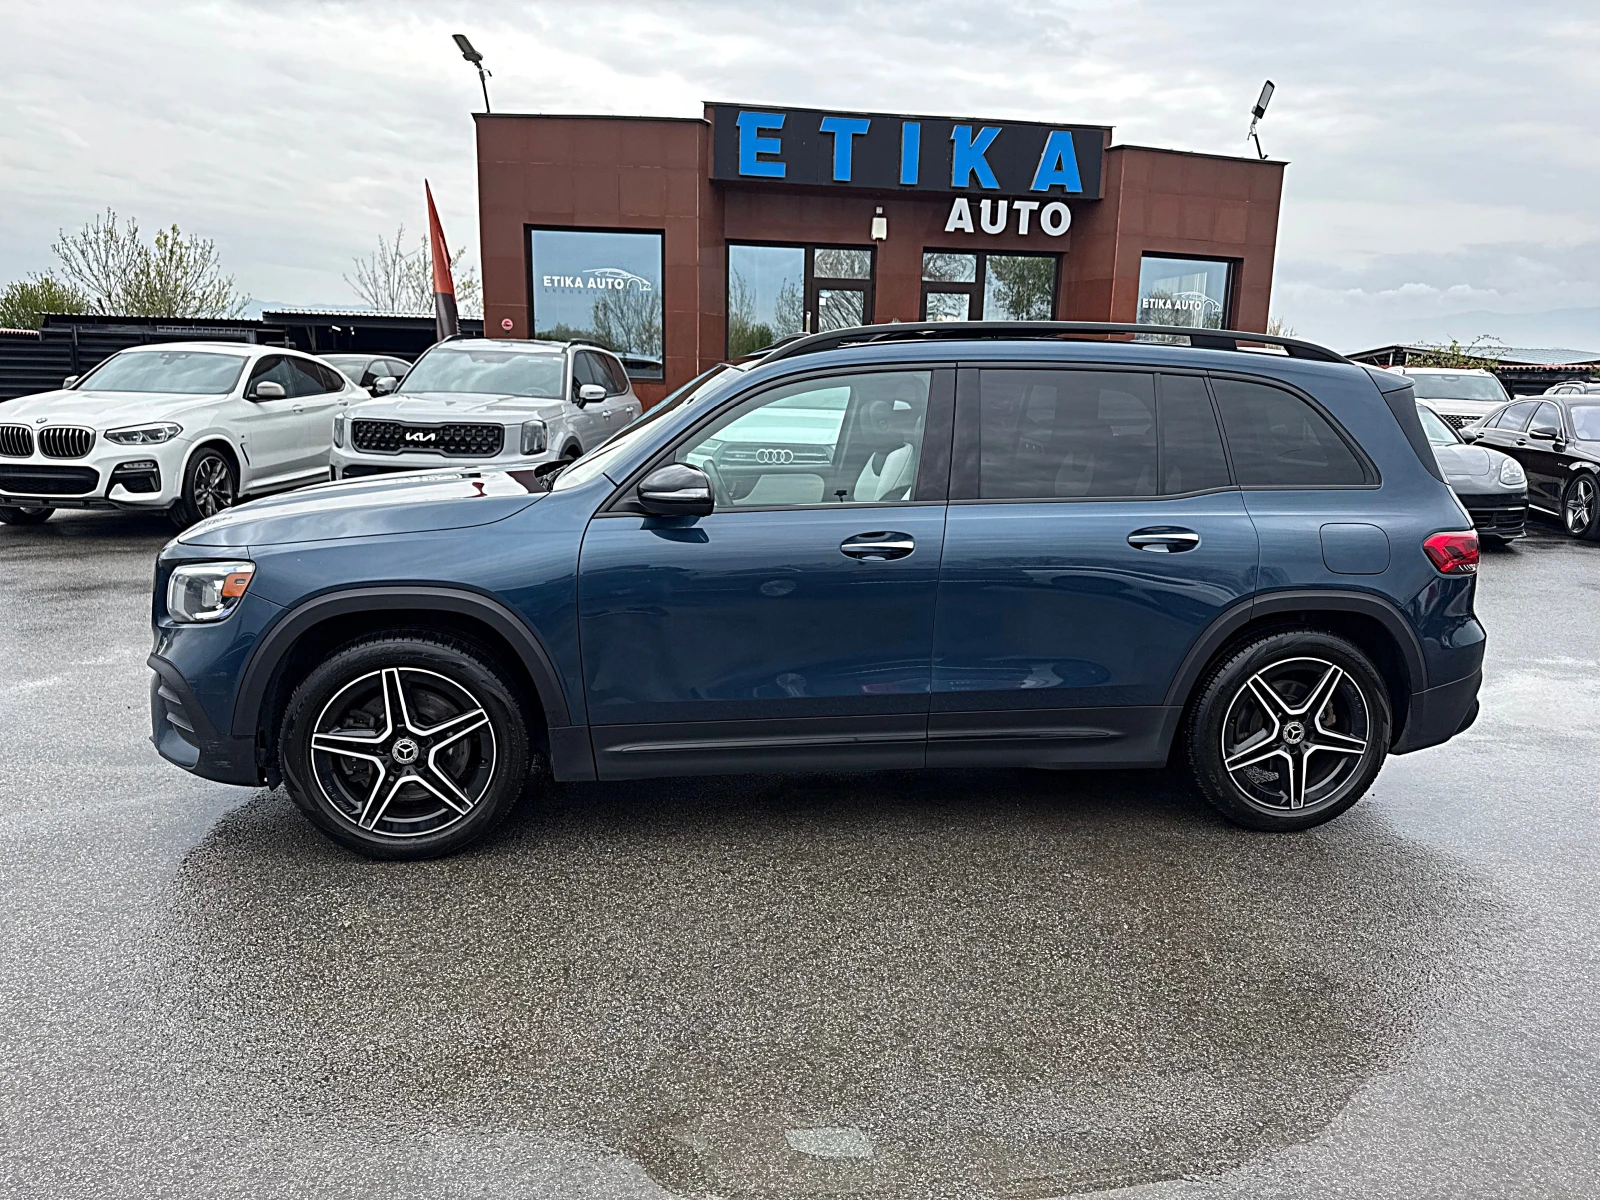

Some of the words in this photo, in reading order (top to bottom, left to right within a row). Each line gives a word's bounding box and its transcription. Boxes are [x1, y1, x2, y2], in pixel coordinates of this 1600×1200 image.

[736, 111, 1083, 193] ETIKA
[944, 198, 1072, 236] AUTO
[543, 275, 583, 288] ETIKA
[587, 277, 624, 289] AUTO
[1142, 298, 1172, 309] ETIKA
[1174, 299, 1201, 310] AUTO
